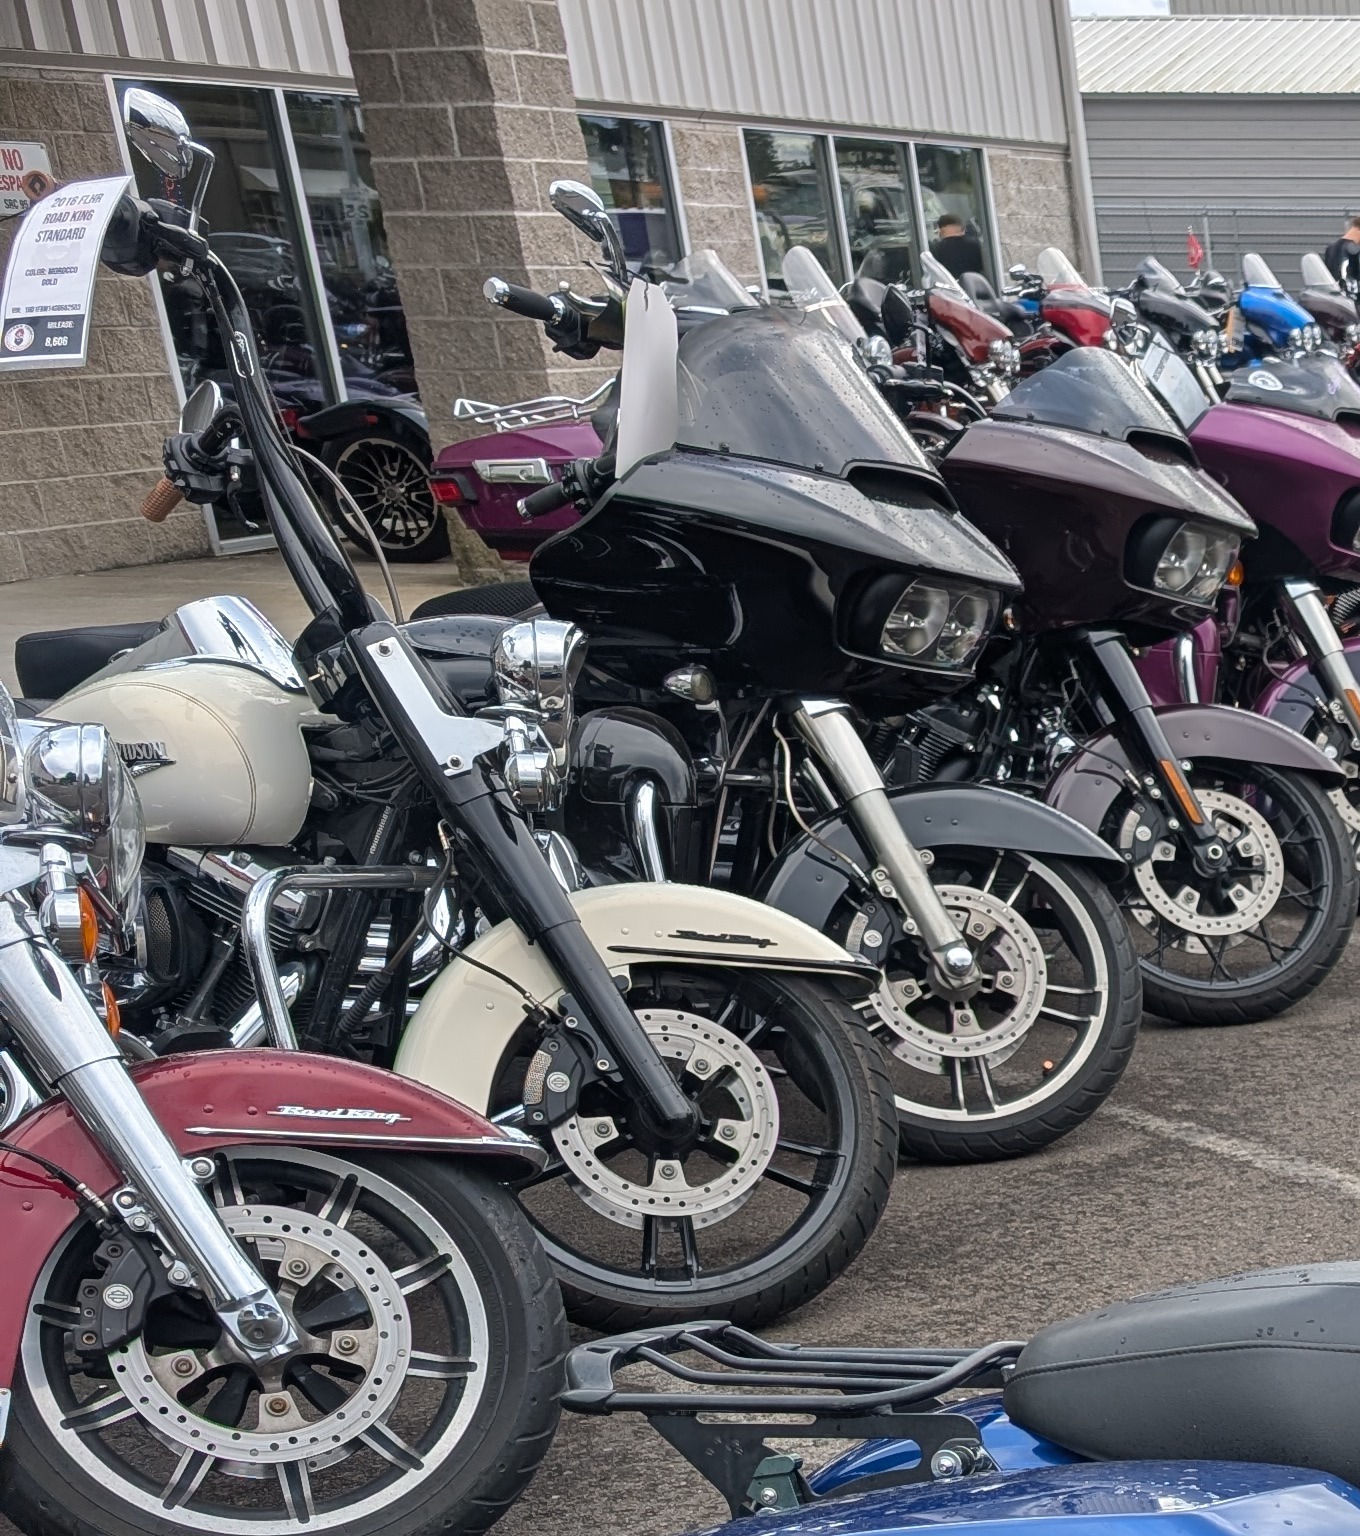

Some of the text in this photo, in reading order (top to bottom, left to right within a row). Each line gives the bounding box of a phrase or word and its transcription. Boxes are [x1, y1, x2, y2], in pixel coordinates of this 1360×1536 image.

[1, 148, 24, 170] NO
[51, 196, 77, 208] 2016
[43, 209, 95, 224] ROAD KING
[35, 227, 87, 243] STANDARD
